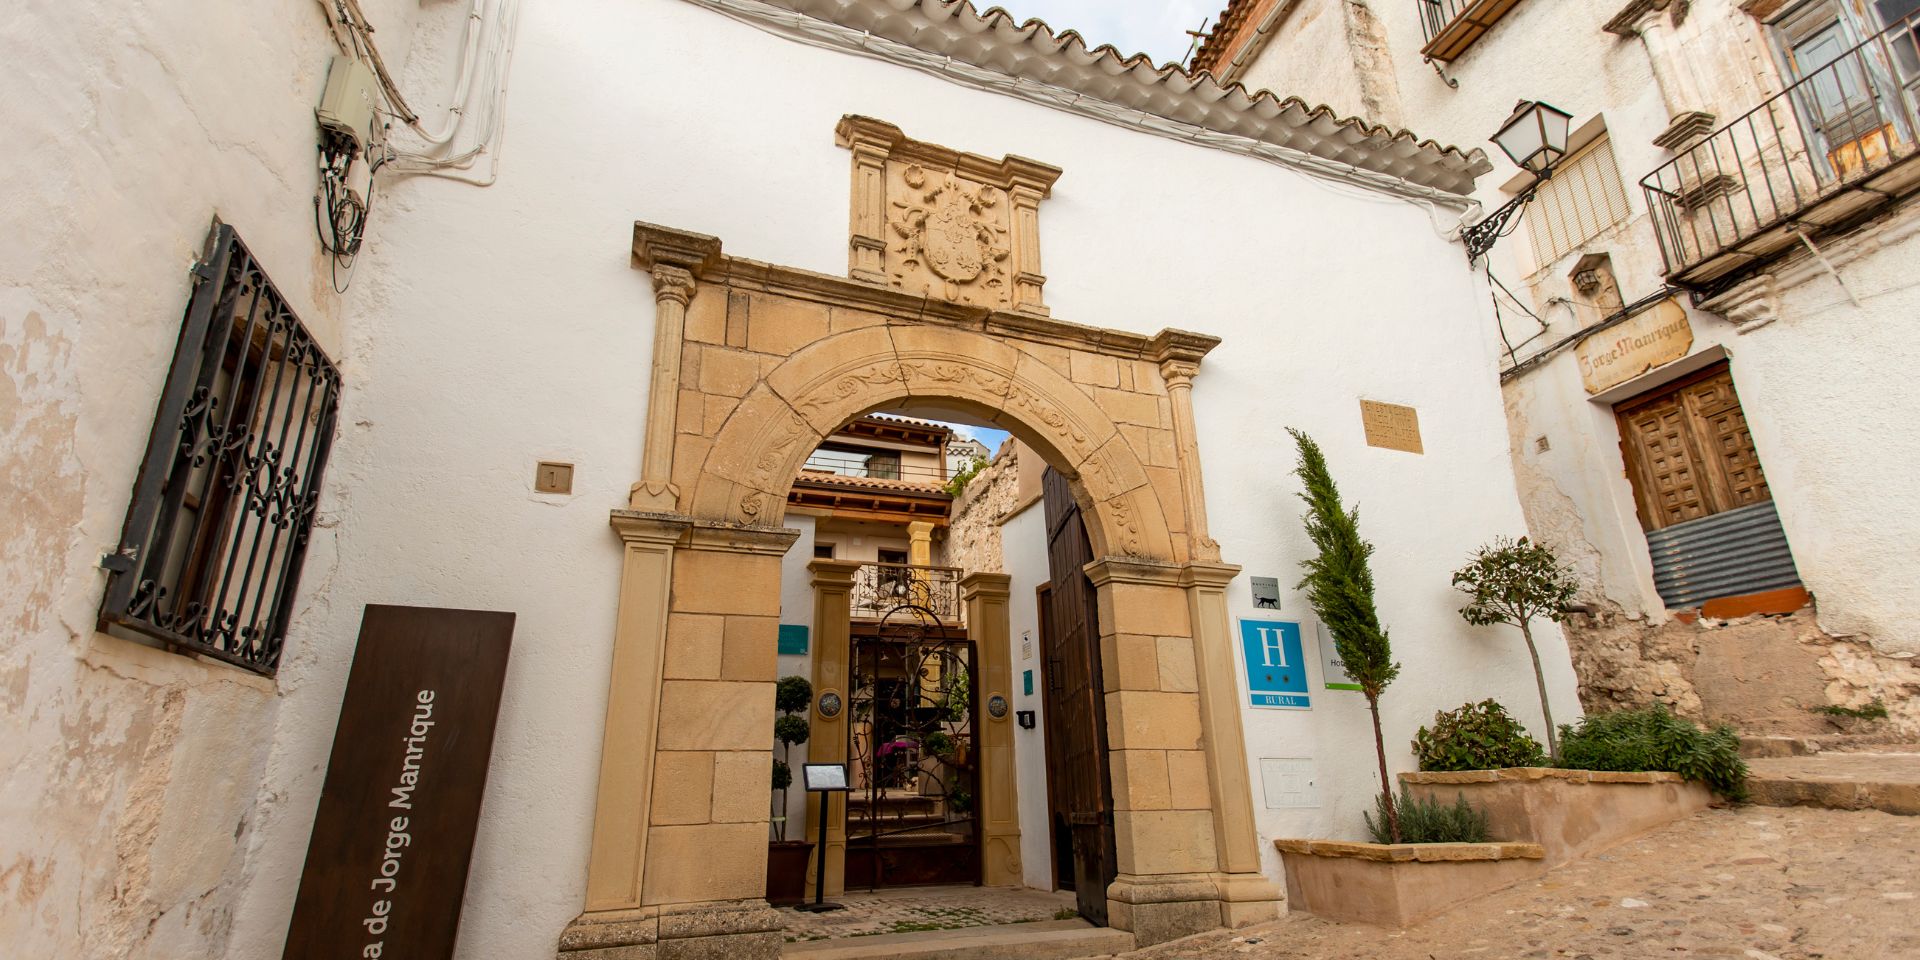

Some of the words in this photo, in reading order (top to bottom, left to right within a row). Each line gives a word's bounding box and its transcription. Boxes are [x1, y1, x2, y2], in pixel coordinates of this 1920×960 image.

[1580, 349, 1618, 378] Jorge
[549, 471, 558, 488] 1
[1257, 627, 1290, 668] H
[1265, 695, 1297, 705] RURAL
[388, 689, 435, 810] Manrique
[372, 816, 411, 893] Jorge
[363, 899, 392, 939] de
